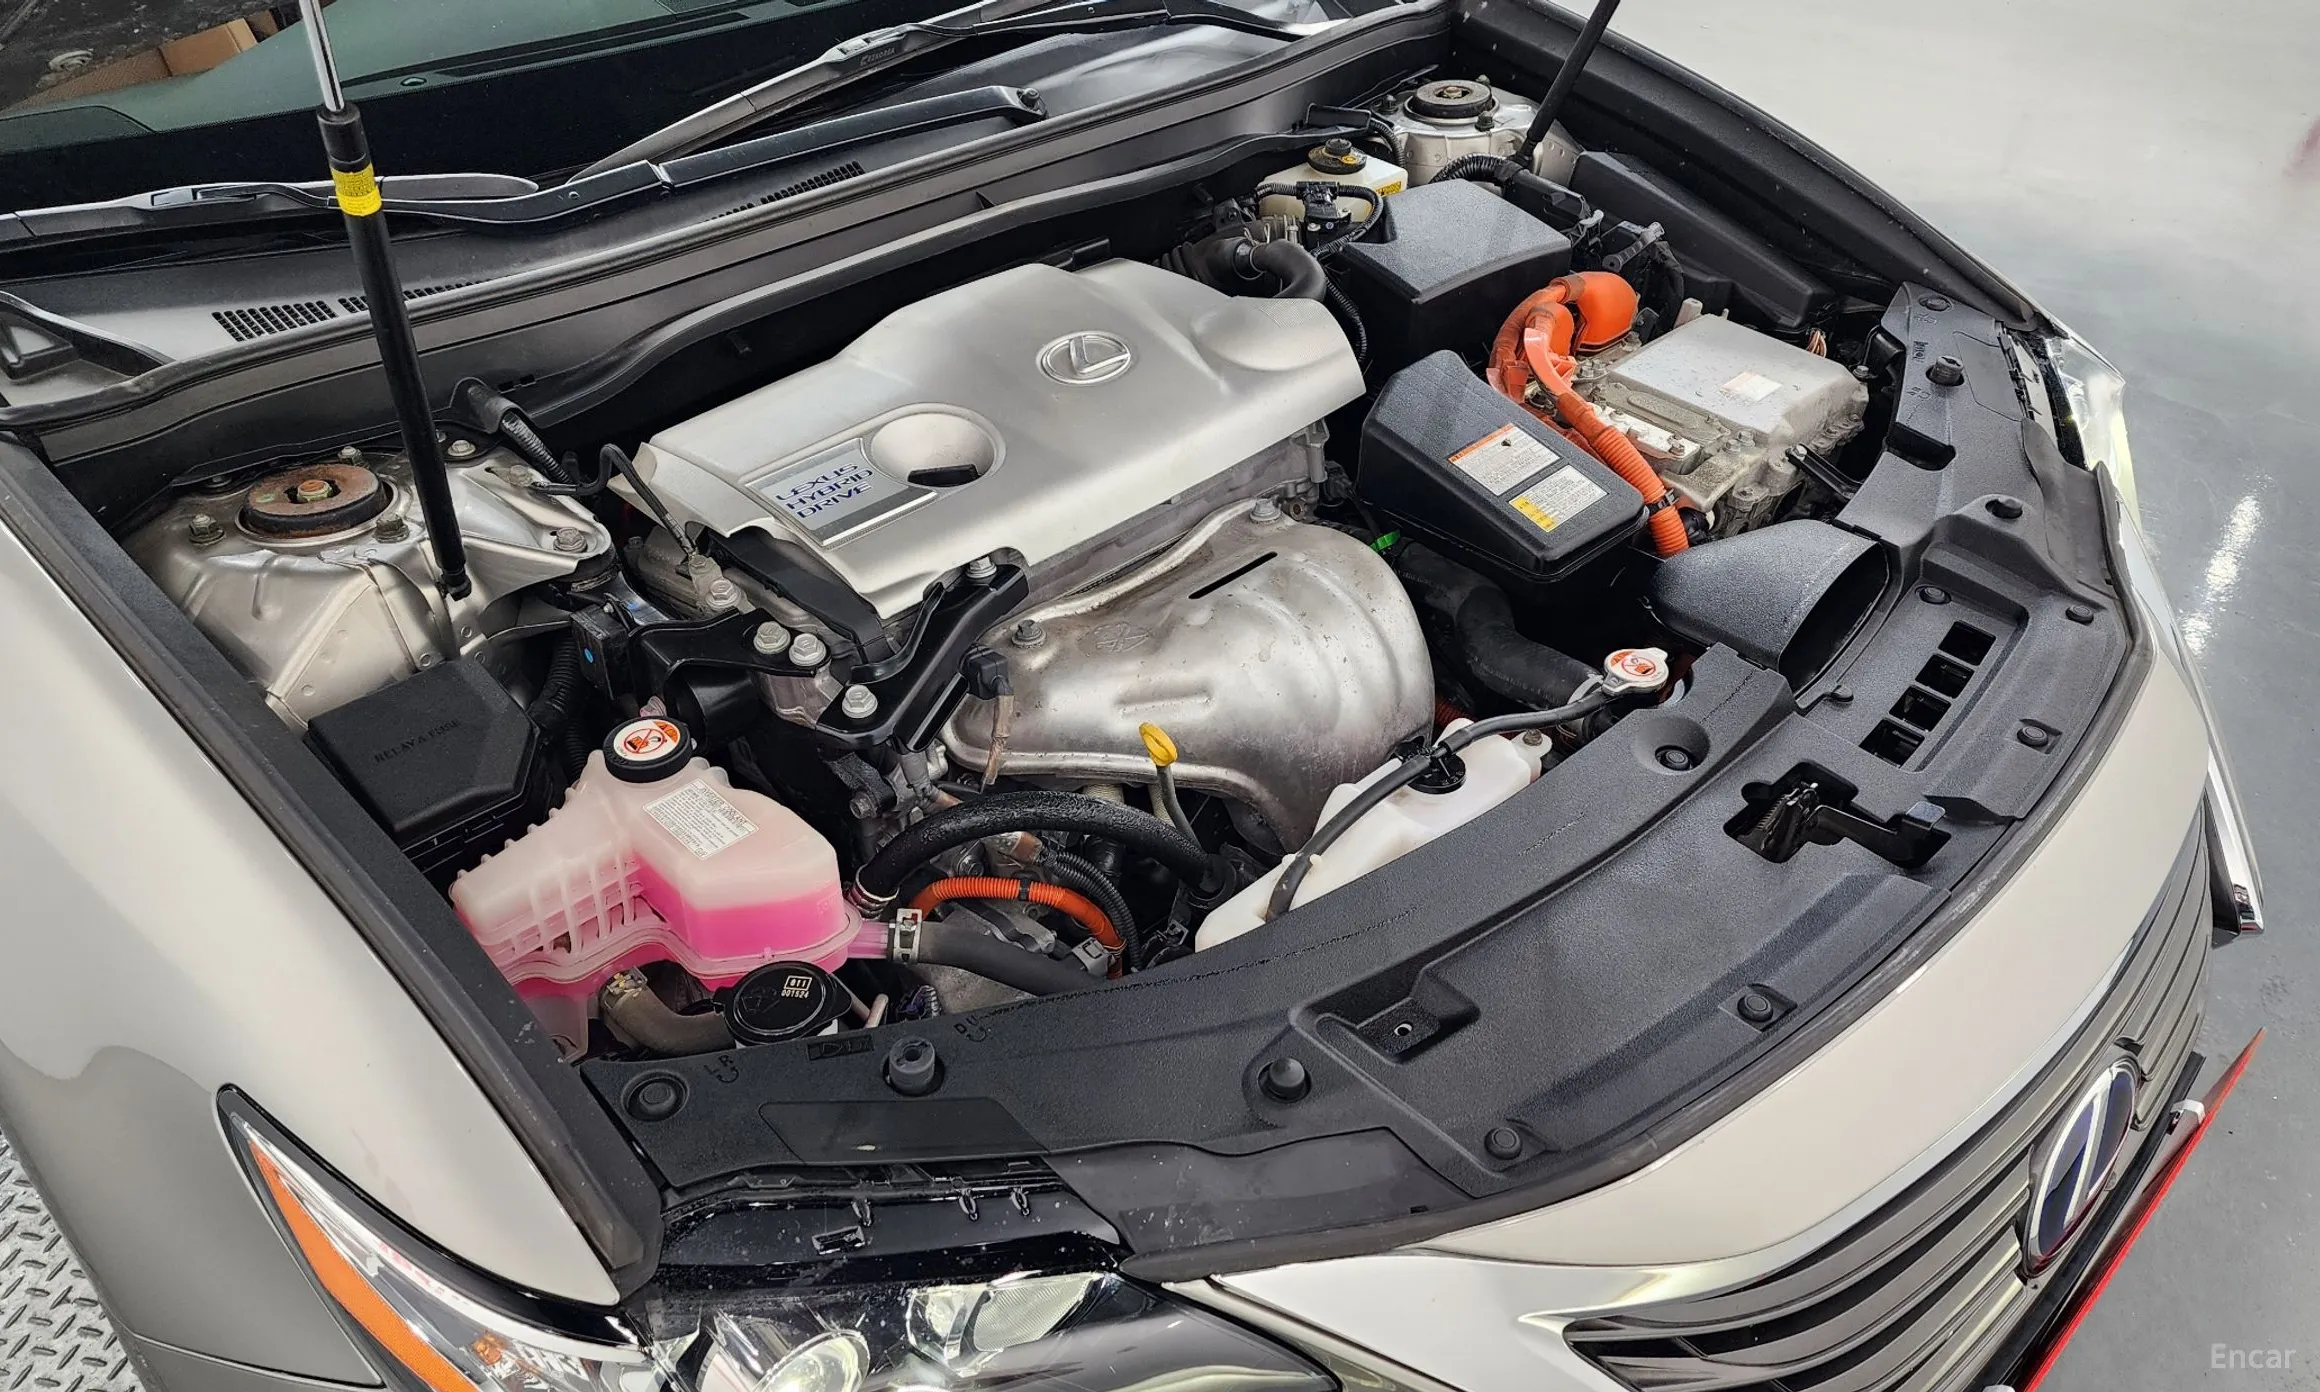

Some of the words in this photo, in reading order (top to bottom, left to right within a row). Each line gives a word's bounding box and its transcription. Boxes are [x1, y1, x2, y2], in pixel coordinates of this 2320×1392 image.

[775, 462, 859, 501] LEXUS
[785, 467, 873, 510] HYBRID
[796, 481, 873, 519] DRIVE
[373, 739, 415, 763] RELAY
